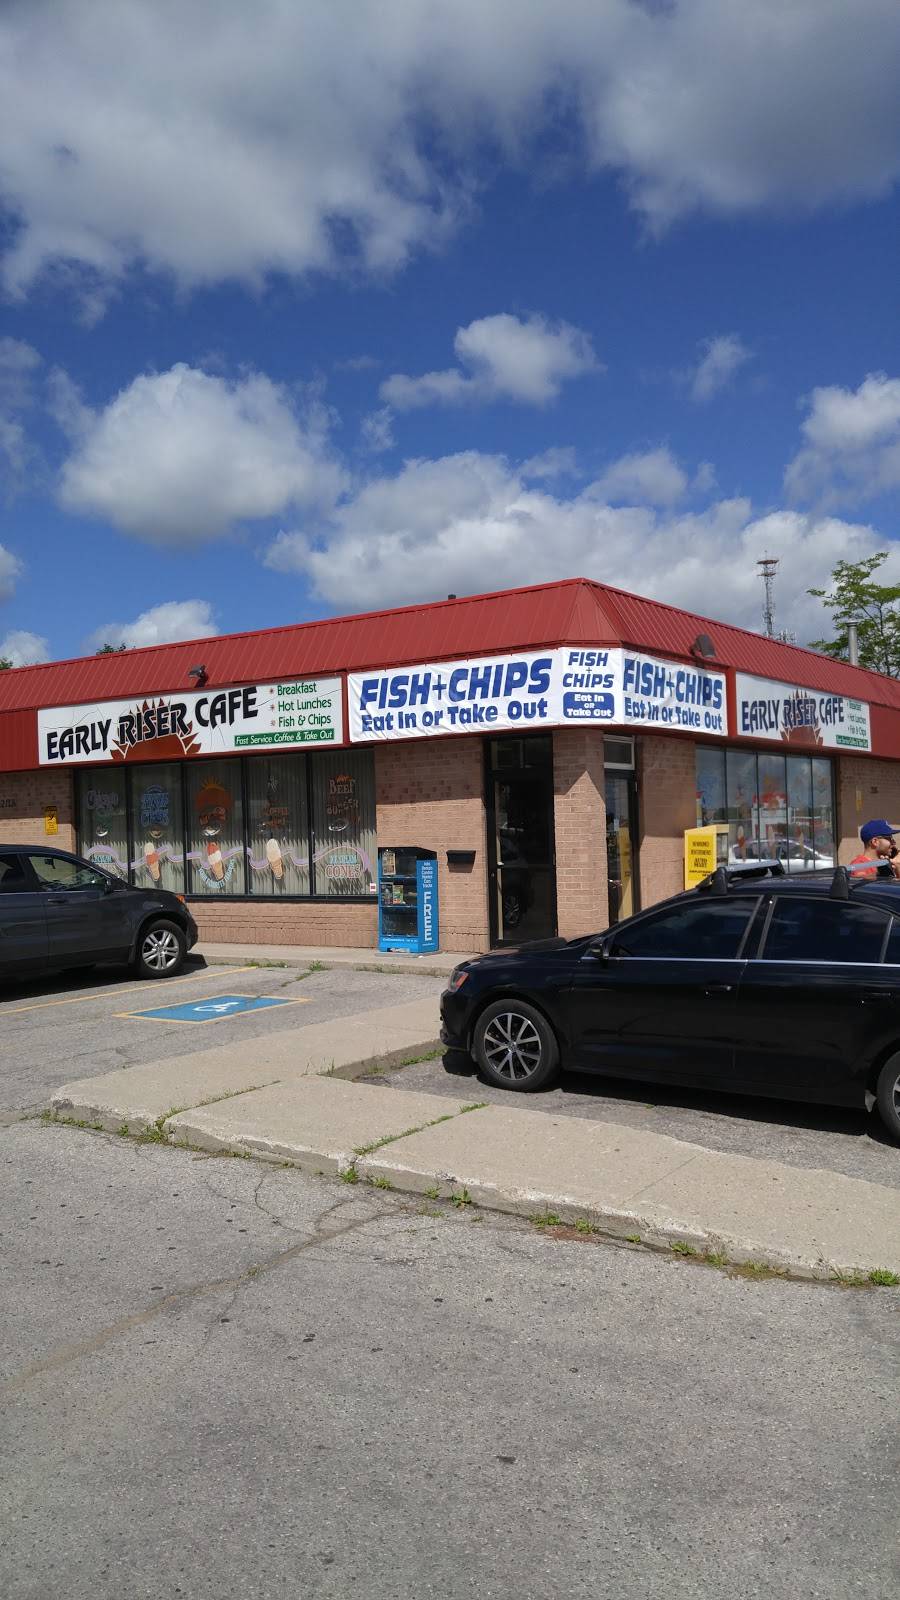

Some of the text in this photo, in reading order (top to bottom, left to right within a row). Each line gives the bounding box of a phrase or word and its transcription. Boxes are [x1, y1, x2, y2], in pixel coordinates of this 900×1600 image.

[568, 652, 609, 667] FISH
[562, 673, 614, 688] CHIPS
[277, 682, 317, 696] Breakfast
[278, 698, 332, 712] Hot Lunches
[574, 694, 604, 702] Eat In
[278, 714, 332, 727] Fish & Chips
[361, 698, 548, 732] Eat In or Take Out
[567, 709, 612, 717] Take Out
[624, 697, 723, 730] Eat In or Take Out
[742, 698, 844, 733] EARLY RISER CAFE
[47, 687, 258, 760] EARLY RISER CAFE
[236, 736, 249, 745] Fast
[250, 735, 272, 744] Service
[274, 733, 295, 742] Coffee
[304, 732, 318, 740] Take
[320, 730, 332, 739] Out
[424, 891, 432, 941] FREE
